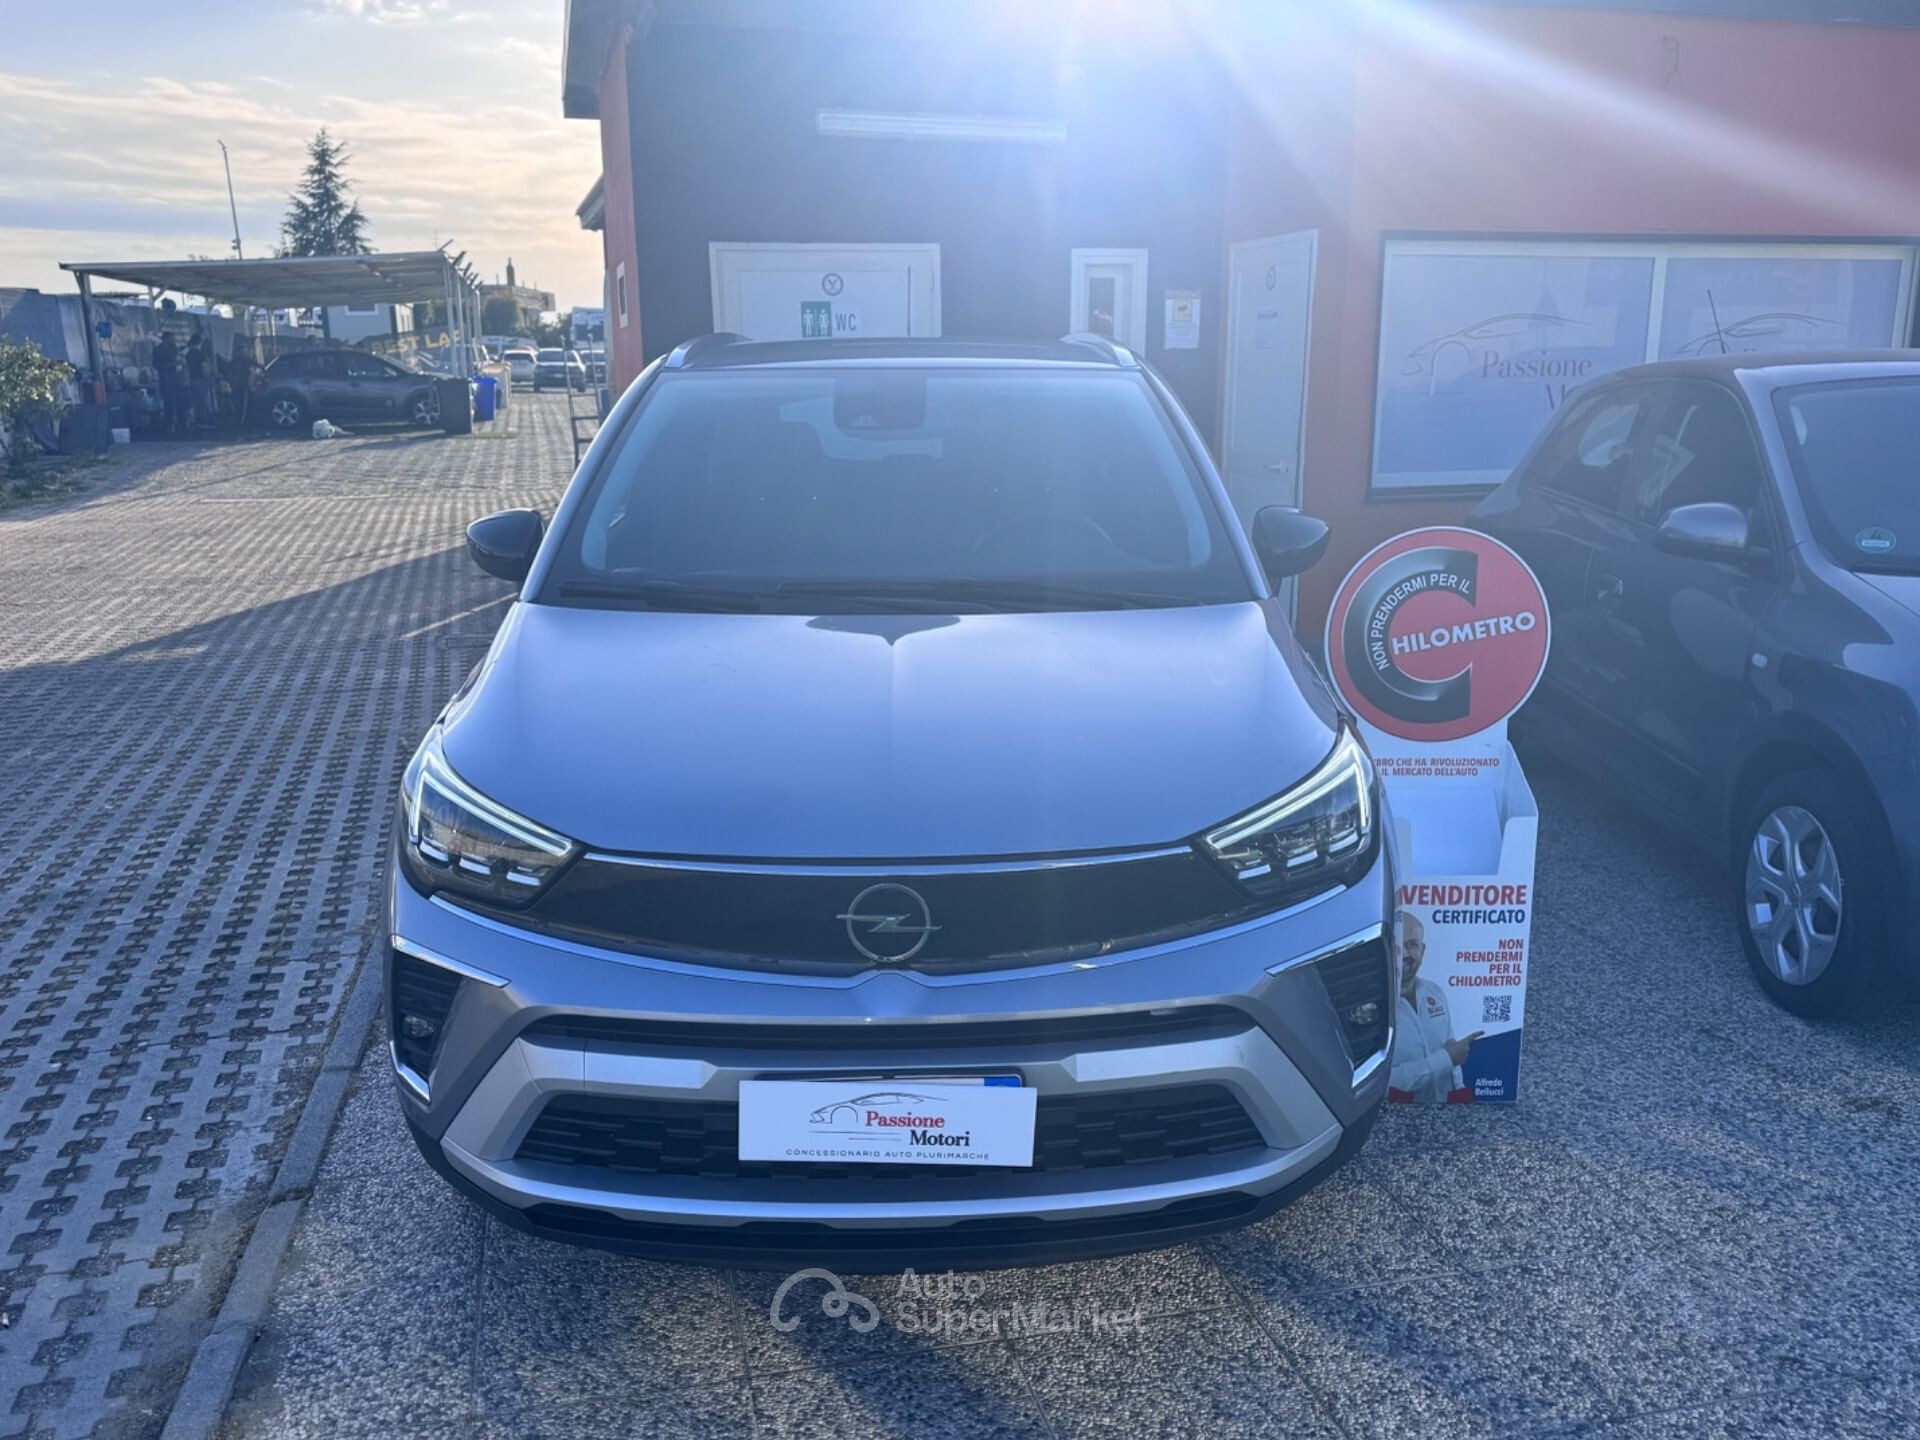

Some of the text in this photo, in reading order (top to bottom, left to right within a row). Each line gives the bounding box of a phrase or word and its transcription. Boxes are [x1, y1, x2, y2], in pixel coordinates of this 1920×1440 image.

[834, 312, 857, 332] WC
[1482, 349, 1593, 378] Passione
[1370, 573, 1471, 671] NON PRENDERMI PER IL
[1396, 758, 1412, 767] CHE
[1414, 758, 1428, 767] HA
[1430, 758, 1500, 767] RIVOLUZIONATO
[1381, 767, 1479, 776] IL MERCATO DELL'AUTO
[1401, 884, 1528, 906] VENDITORE
[1431, 909, 1526, 924] CERTIFICATO
[1498, 938, 1524, 950] NON
[1455, 951, 1523, 963] PRENDERMI
[1488, 963, 1523, 975] PER IL
[1447, 975, 1522, 987] CHILOMETRO
[1474, 1078, 1503, 1087] Alfredo
[1474, 1088, 1504, 1097] Bellucci
[865, 1110, 945, 1128] Passione
[909, 1130, 971, 1147] Motori
[785, 1148, 990, 1161] CONCESSIONARIO AUTO PLURIMARCHE
